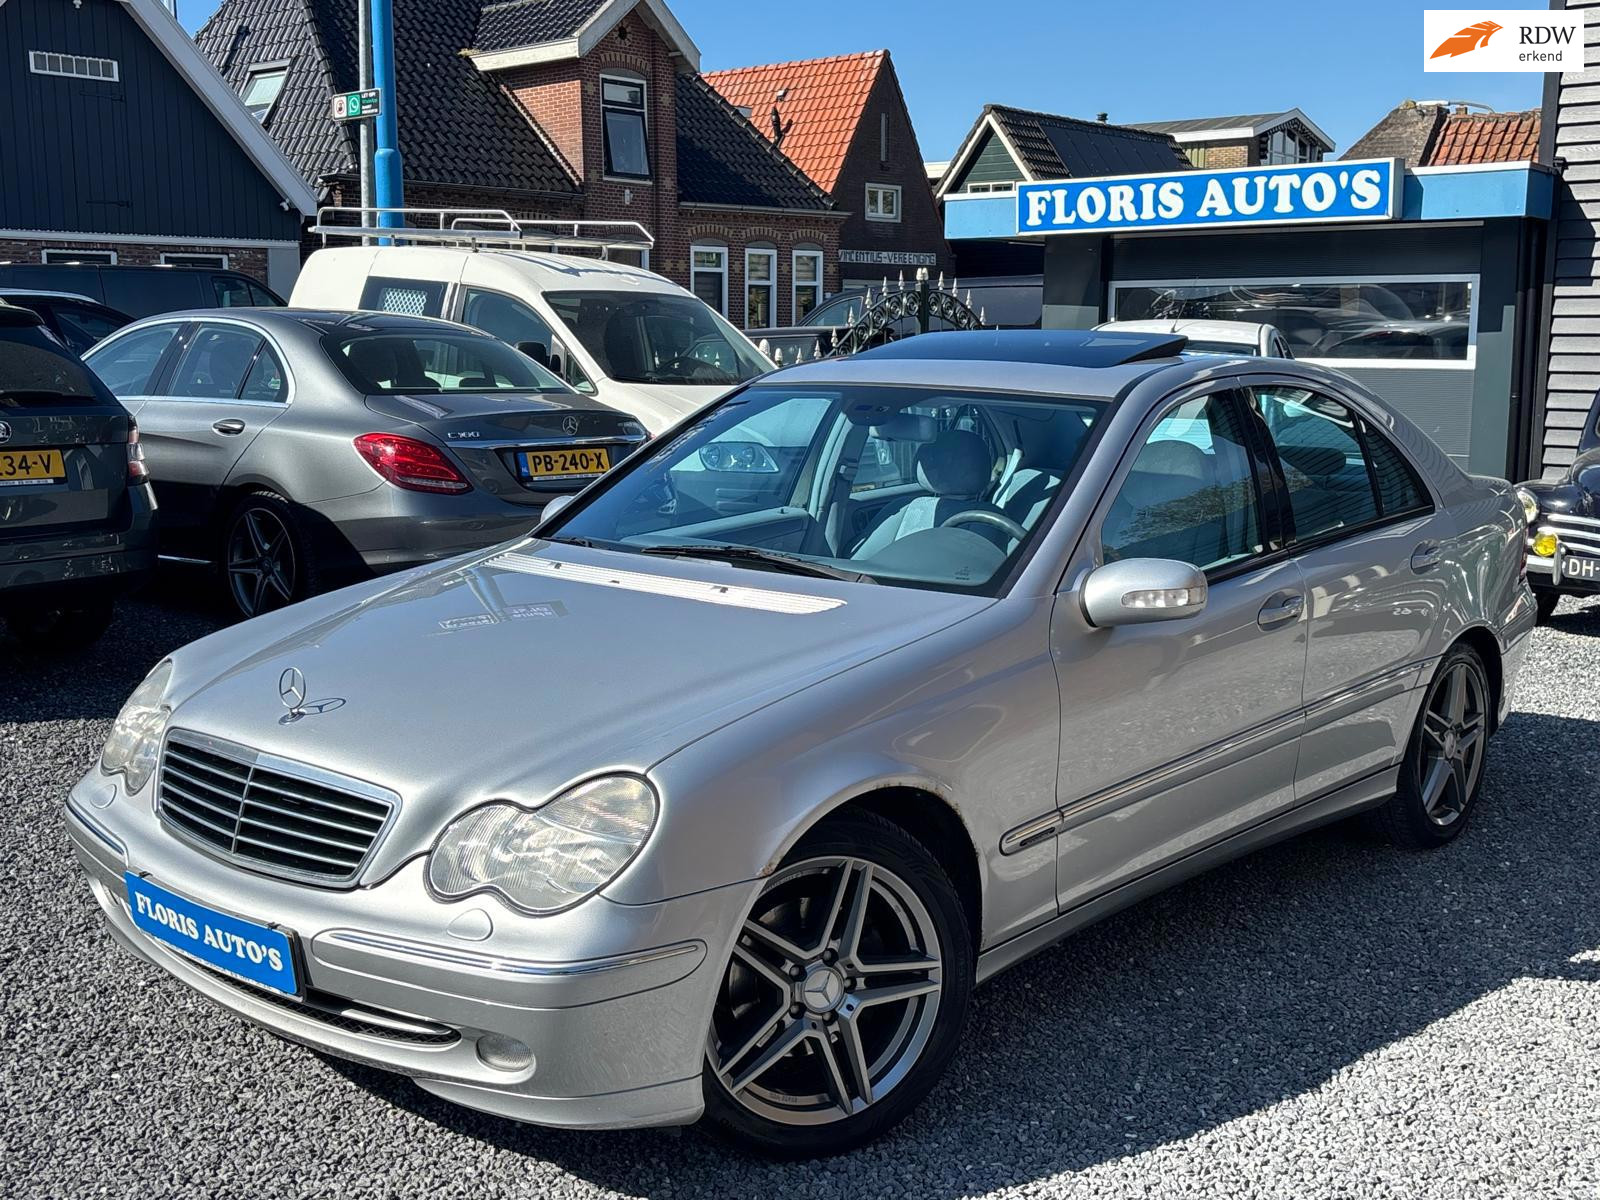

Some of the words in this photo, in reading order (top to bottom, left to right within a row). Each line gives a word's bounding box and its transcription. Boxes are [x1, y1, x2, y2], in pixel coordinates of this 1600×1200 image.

[1025, 181, 1184, 226] FLORIS
[1196, 169, 1382, 217] AUTO'S
[0, 454, 51, 476] 34-V
[532, 452, 605, 473] PB-240-X
[134, 891, 199, 940] FLORIS
[203, 924, 284, 972] AUTO'S
